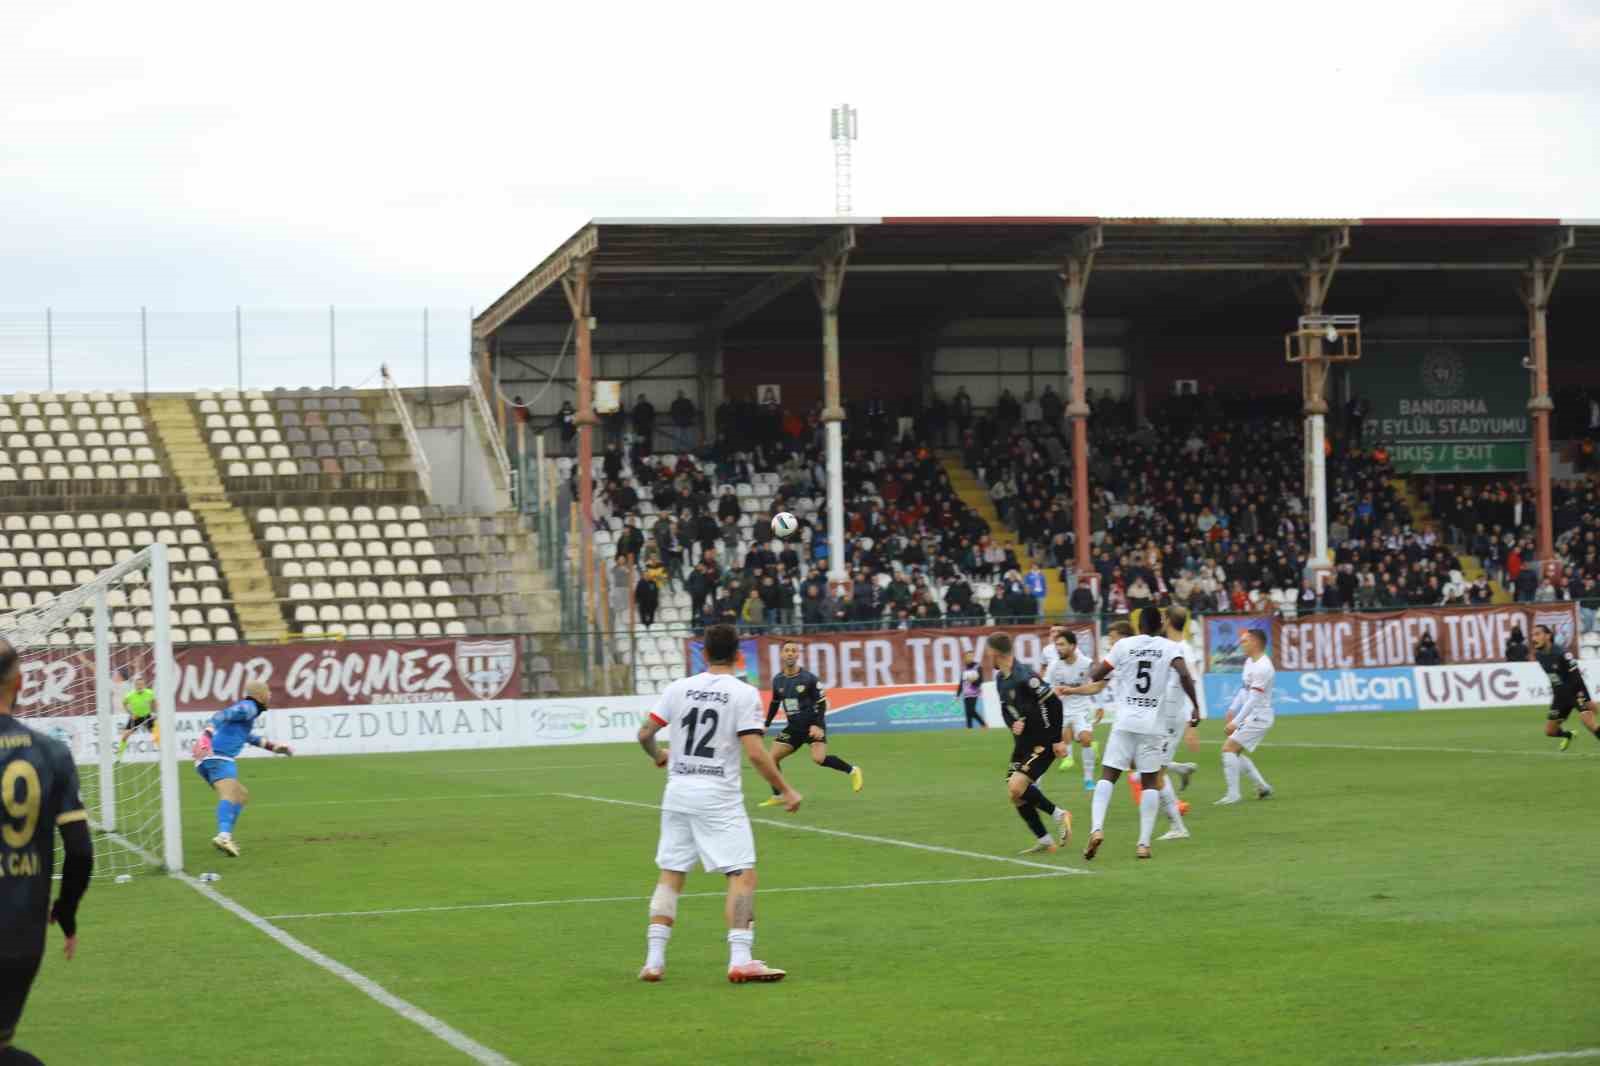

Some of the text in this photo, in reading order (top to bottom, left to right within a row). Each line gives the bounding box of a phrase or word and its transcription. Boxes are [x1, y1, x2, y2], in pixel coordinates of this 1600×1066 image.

[1400, 399, 1488, 416] BANDIRMA
[1383, 415, 1435, 435] EYLÜL
[1438, 418, 1527, 434] STADYUMU
[1453, 444, 1495, 461] EXIT
[1135, 661, 1152, 694] 5
[1299, 671, 1414, 703] Sultan
[1423, 668, 1520, 703] UMG
[681, 707, 719, 758] 12
[2, 759, 42, 848] 9
